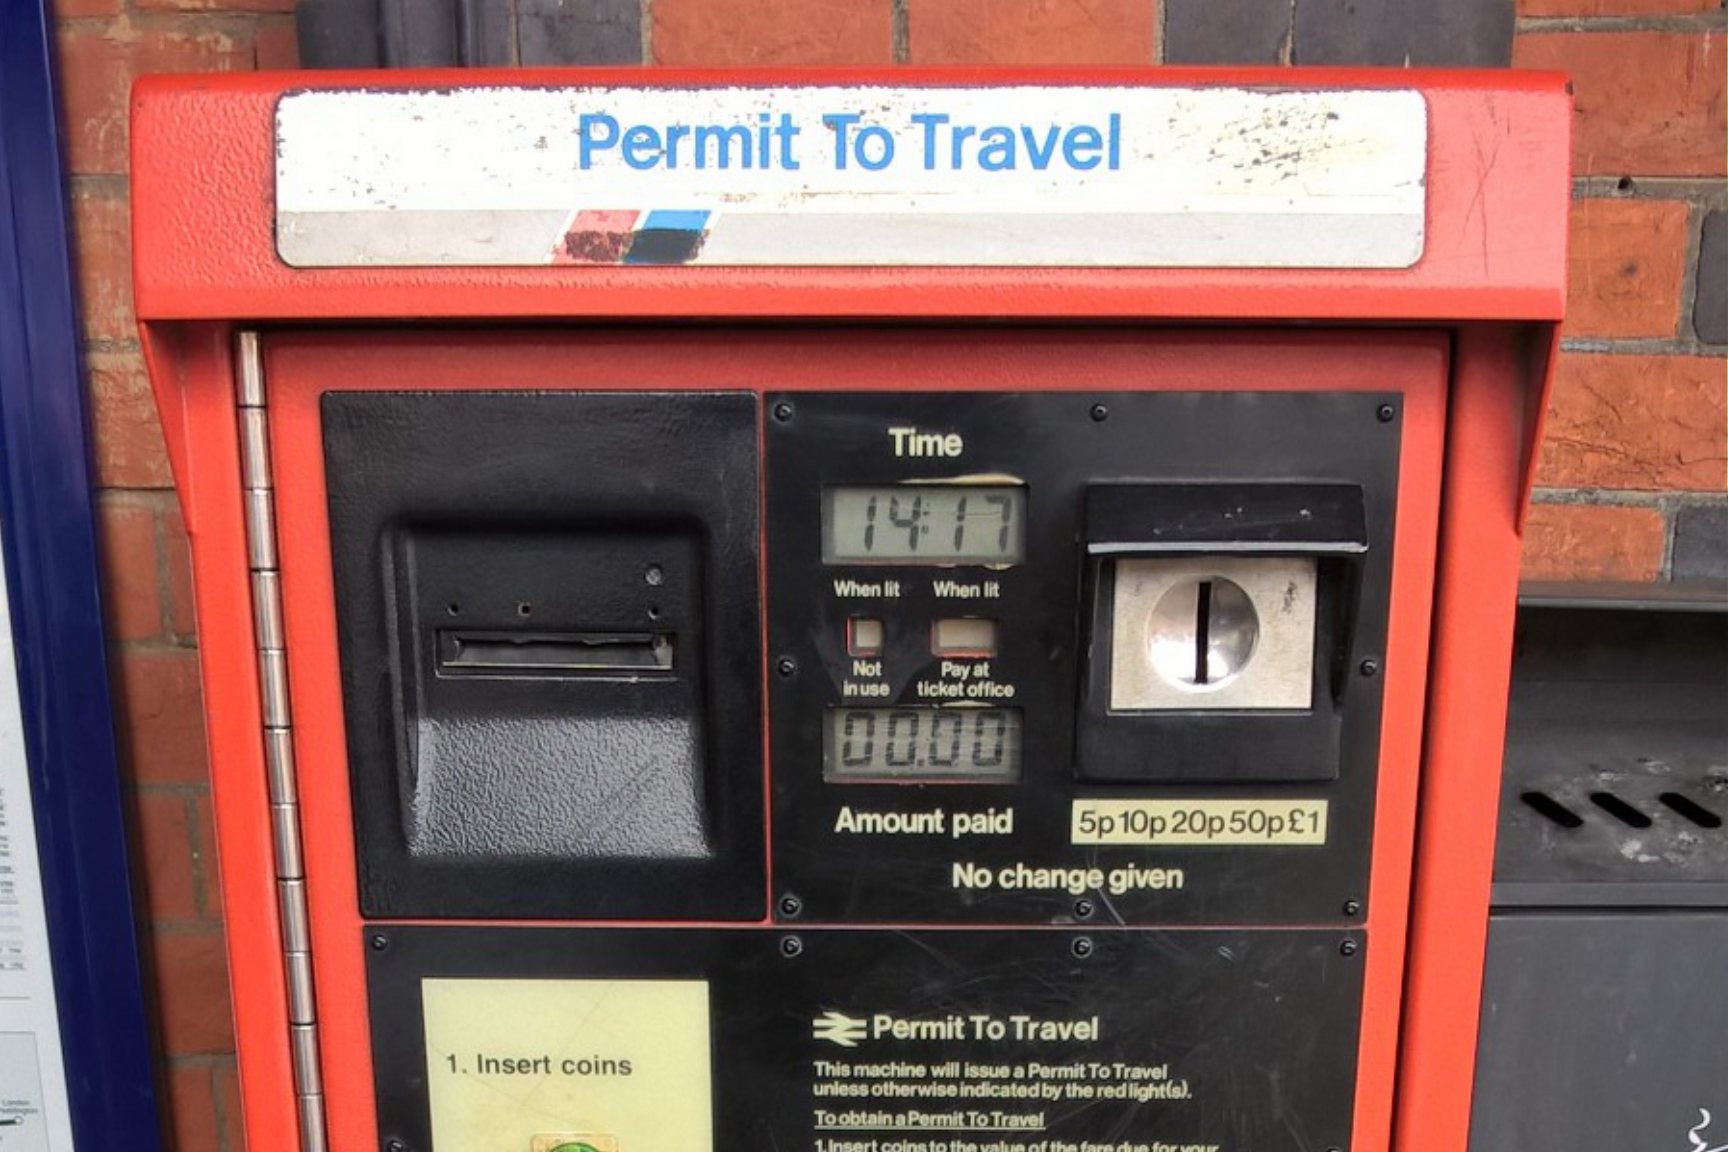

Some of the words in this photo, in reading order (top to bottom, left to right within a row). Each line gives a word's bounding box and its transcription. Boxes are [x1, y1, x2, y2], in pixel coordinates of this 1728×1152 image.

[579, 114, 800, 171] Permit
[822, 114, 895, 172] To
[911, 114, 1121, 172] Travel
[889, 428, 962, 457] Time
[864, 495, 1013, 551] 14:17
[834, 580, 881, 597] When
[884, 580, 900, 597] lit
[933, 580, 980, 597] When
[984, 581, 1000, 597] lit
[853, 661, 882, 677] Not
[942, 662, 970, 679] Pay
[973, 662, 990, 678] at
[843, 681, 858, 696] in
[861, 683, 890, 696] use
[917, 681, 963, 697] ticket
[966, 682, 1015, 697] office
[835, 807, 944, 834] Amount
[953, 808, 1013, 838] paid
[1079, 810, 1114, 838] 5p
[1121, 811, 1166, 838] 10p
[1171, 811, 1225, 838] 20p
[1229, 811, 1285, 839] 50p
[1288, 812, 1319, 834] £1
[953, 863, 992, 888] No
[999, 863, 1103, 894] change
[1108, 865, 1183, 894] given
[874, 1015, 965, 1040] Permit
[969, 1016, 1006, 1040] To
[1010, 1016, 1098, 1041] Travel
[446, 1055, 467, 1074] 1.
[477, 1055, 552, 1075] Insert
[562, 1056, 632, 1076] coins
[814, 1062, 850, 1077] This
[854, 1063, 926, 1078] machine
[931, 1064, 959, 1079] will
[965, 1064, 1010, 1080] issue
[1013, 1068, 1024, 1080] a
[1028, 1065, 1086, 1081] Permit
[1088, 1066, 1110, 1081] To
[1113, 1066, 1168, 1082] Travel
[813, 1082, 868, 1097] unless
[871, 1082, 958, 1098] otherwise
[960, 1083, 1042, 1099] indicated
[1042, 1084, 1062, 1102] by
[1065, 1084, 1094, 1099] the
[1097, 1084, 1127, 1099] red
[1129, 1081, 1192, 1103] light(s).
[814, 1110, 836, 1126] To
[839, 1110, 892, 1126] obtain
[895, 1114, 905, 1126] a
[908, 1111, 964, 1127] Permit
[966, 1111, 988, 1127] To
[990, 1112, 1044, 1128] Travel
